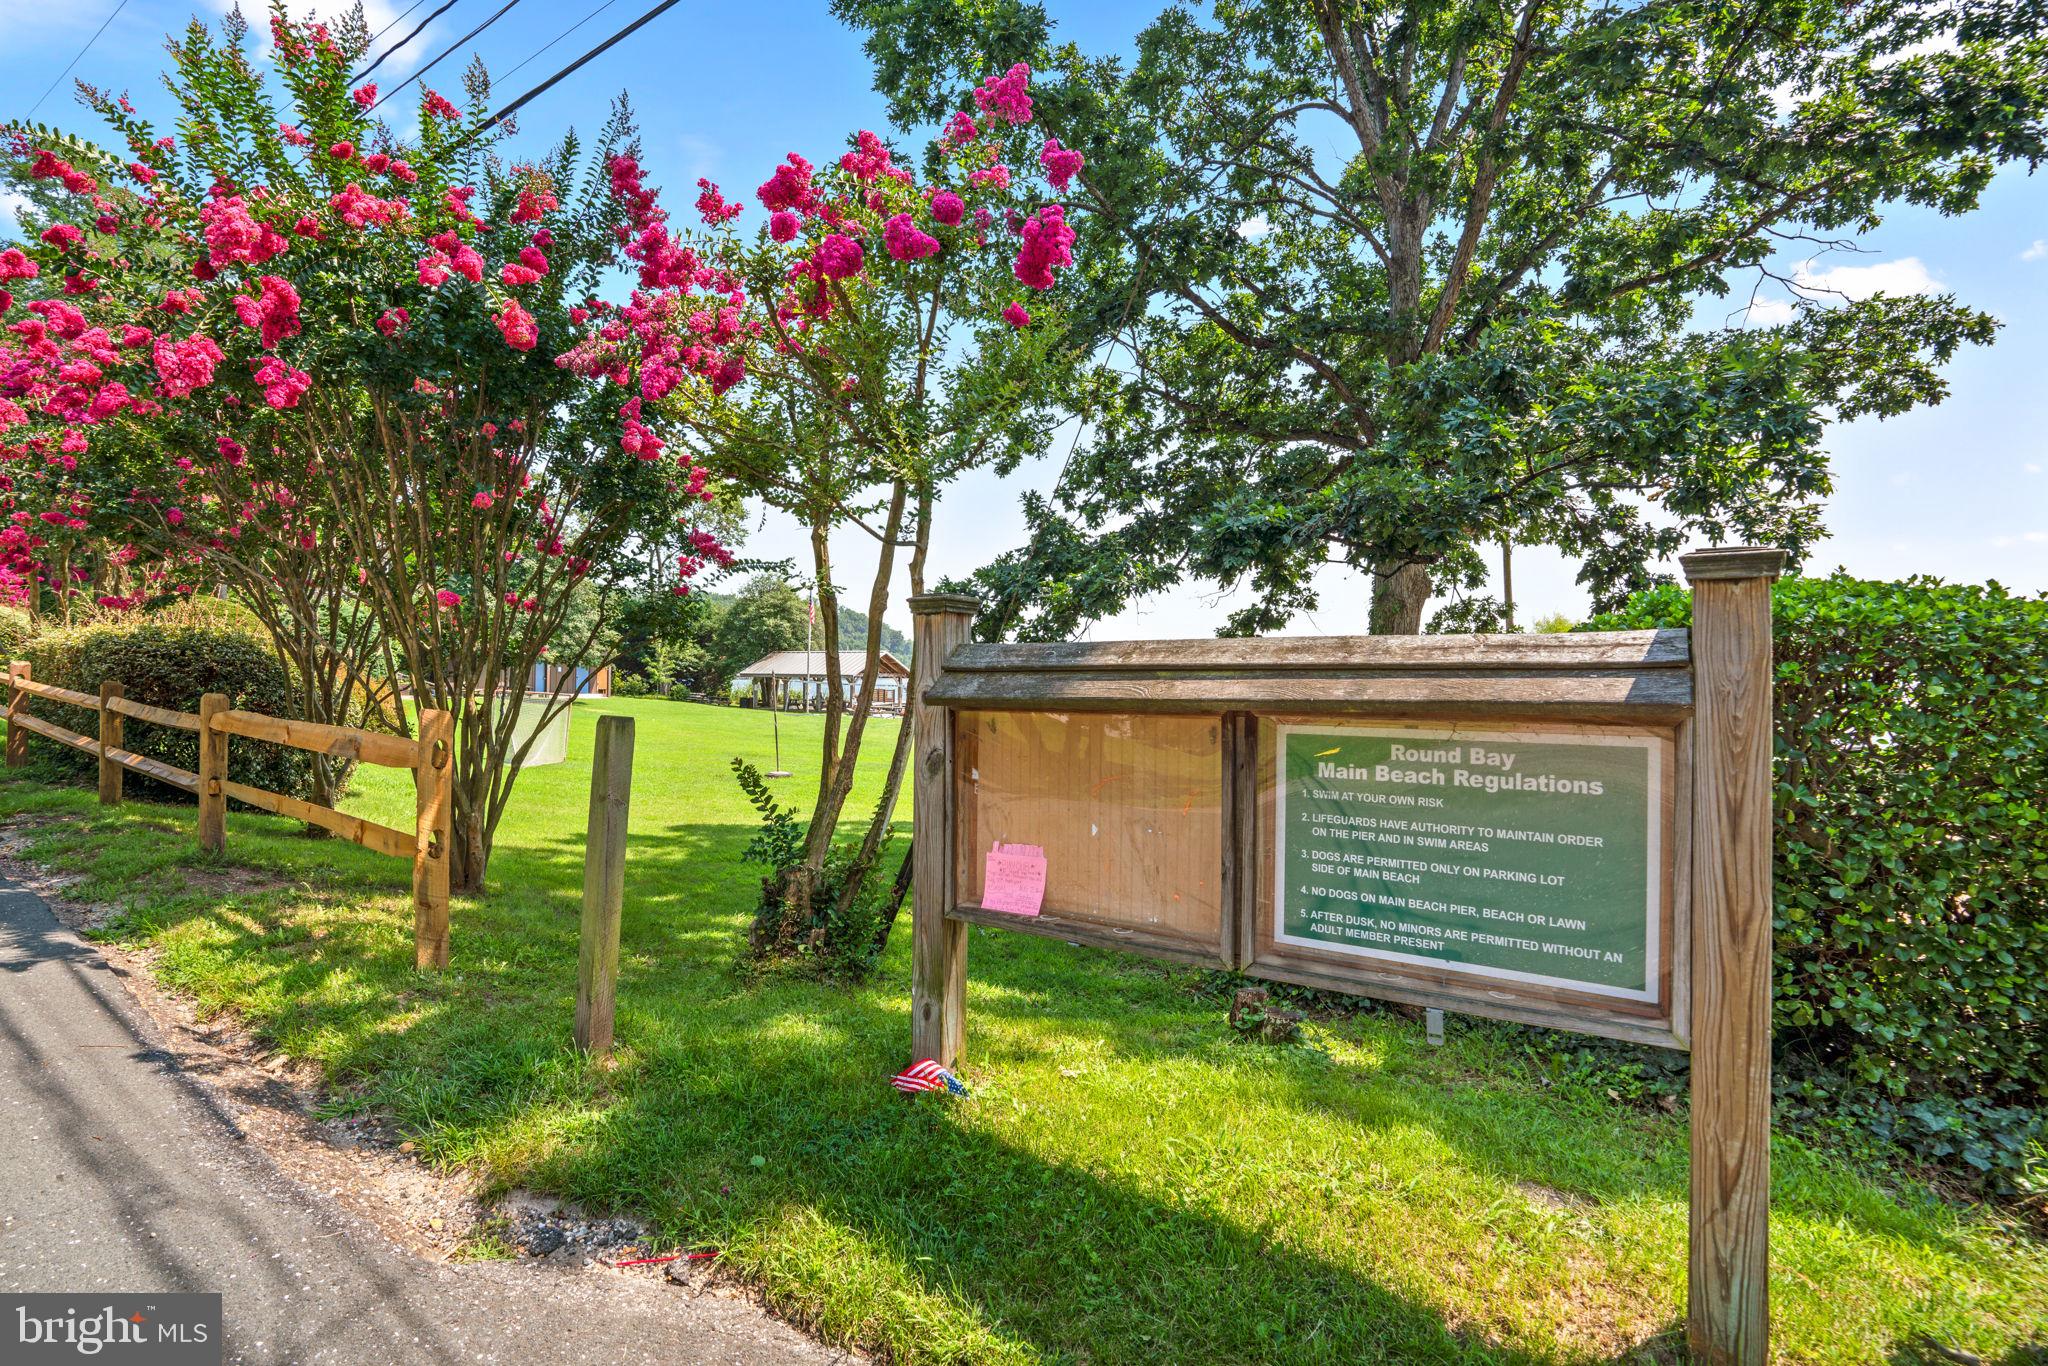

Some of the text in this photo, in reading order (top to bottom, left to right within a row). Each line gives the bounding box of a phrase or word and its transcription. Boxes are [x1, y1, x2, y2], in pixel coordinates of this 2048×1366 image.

[1390, 744, 1515, 770] Round Bay
[1318, 762, 1603, 795] Main Beach Regulations
[1302, 789, 1443, 808] 1. SWIM AT YOUR OWN RISK
[1302, 813, 1602, 847] 2. LIFEGUARDS HAVE AUTHORITY TO MAINTAIN ORDER
[1312, 826, 1488, 852] ON THE PIER AND IN SWIM AREAS
[1301, 849, 1564, 887] 3. DOGS ARE PERMITTED ONLY ON PARKING LOT
[1311, 863, 1419, 884] SIDE OF MAIN BEACH
[1300, 885, 1585, 931] 4. NO DOGS ON MAIN BEACH PIER, BEACH OR LAWN
[1300, 908, 1622, 964] 5. AFTER DUSK, NO MINORS ARE PERMITTED WITHOUT AN
[1310, 922, 1444, 952] ADULT MEMBER PRESENT
